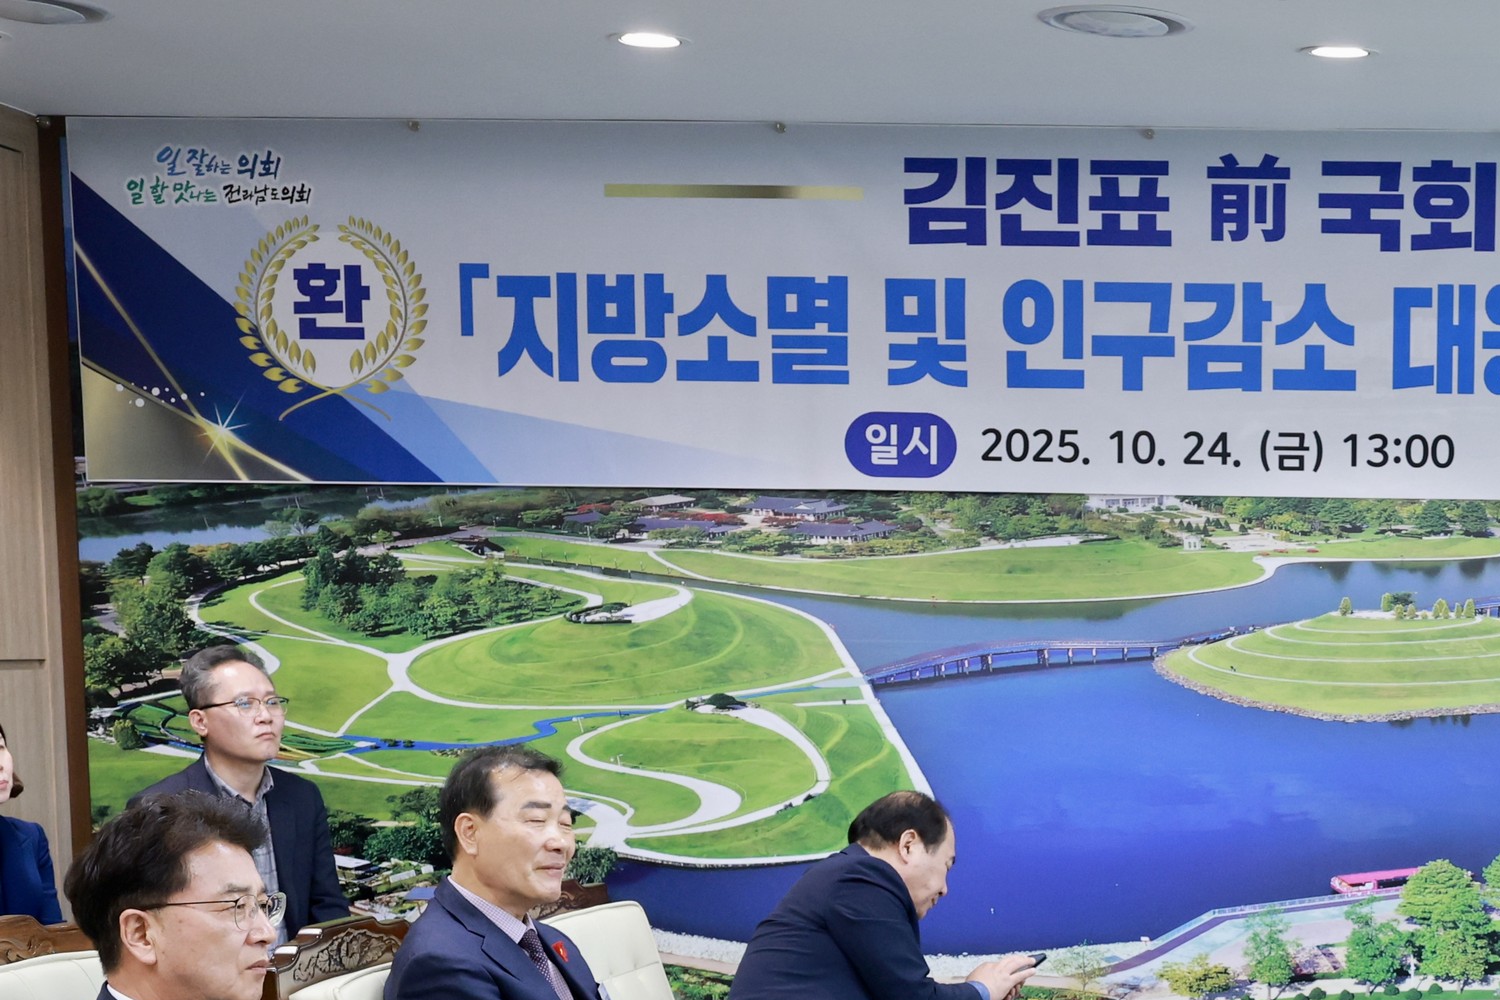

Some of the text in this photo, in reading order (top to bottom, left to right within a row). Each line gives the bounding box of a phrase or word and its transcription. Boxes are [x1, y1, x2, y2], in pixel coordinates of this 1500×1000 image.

[222, 183, 312, 206] 전라남도의회
[237, 150, 281, 179] 의회
[904, 157, 1172, 247] 김진표
[1207, 153, 1291, 242] 前
[293, 262, 370, 340] 환
[459, 263, 850, 385] 「지방소멸
[884, 278, 968, 387] 및
[1002, 279, 1356, 391] 인구감소
[864, 424, 1455, 472] 일시 2025. 10. 24. (금) 13:00
